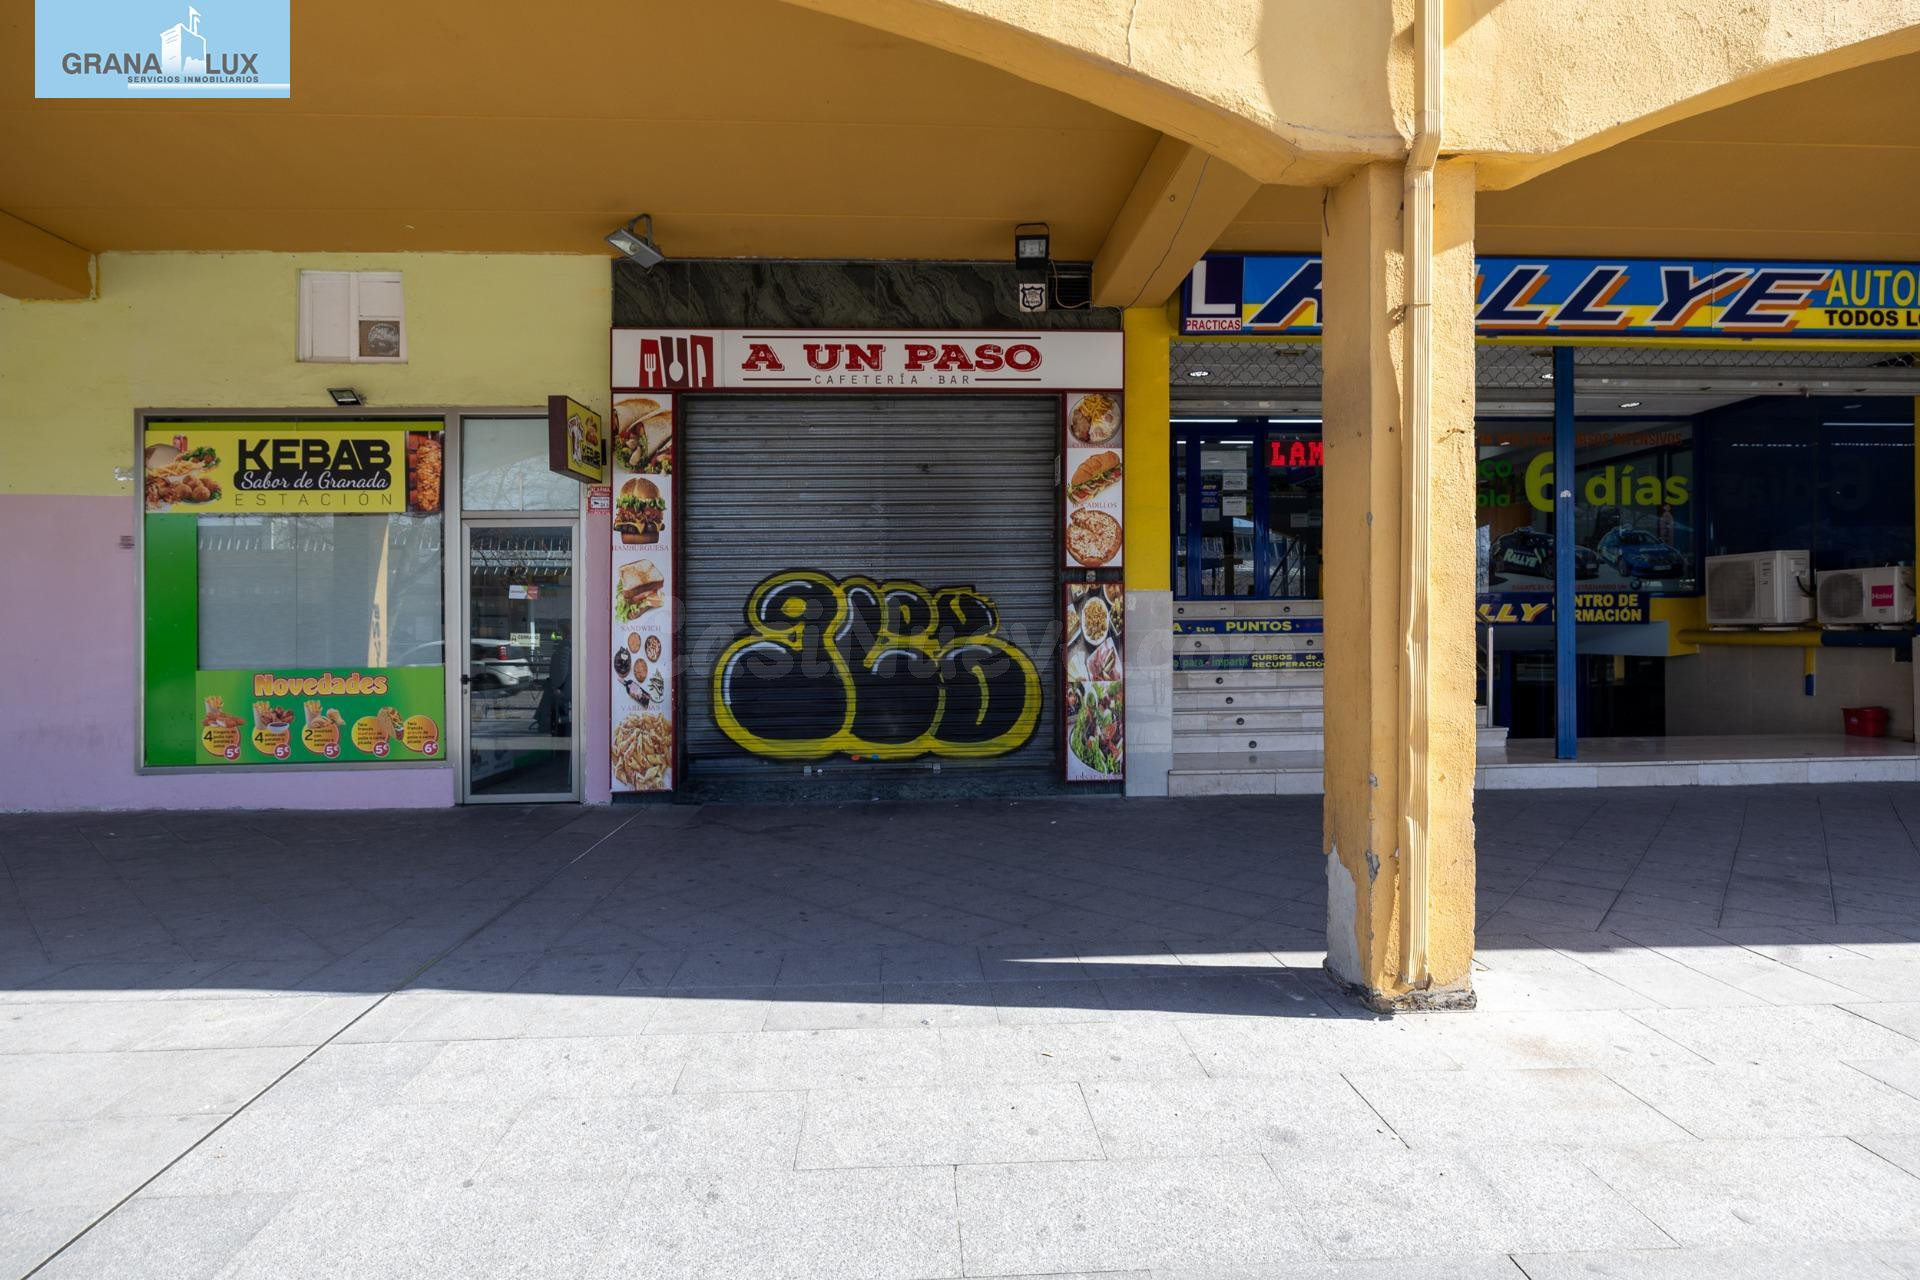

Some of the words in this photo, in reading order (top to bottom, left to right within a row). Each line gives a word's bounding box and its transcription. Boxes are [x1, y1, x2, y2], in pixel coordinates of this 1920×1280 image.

[1825, 268, 1920, 307] AUTO
[1186, 318, 1241, 331] PRACTICAS
[1825, 310, 1899, 326] TODOS
[1906, 310, 1920, 326] L
[742, 344, 785, 372] A
[803, 344, 886, 372] UN
[904, 344, 1043, 372] PASO
[814, 373, 918, 385] CAFETERÍA
[938, 375, 970, 385] BAR
[238, 439, 392, 471] KEBAB
[241, 471, 290, 489] Sabor
[293, 471, 314, 489] de
[318, 471, 389, 489] Granada
[1584, 465, 1690, 507] días
[235, 491, 393, 506] ESTACIÓN
[1618, 594, 1638, 606] DE
[1226, 621, 1292, 632] PUNTOS
[1251, 660, 1325, 668] RECUPERACIÓ
[253, 673, 388, 697] Novedades
[203, 730, 214, 742] 4
[254, 731, 264, 743] 4
[304, 729, 313, 741] 2
